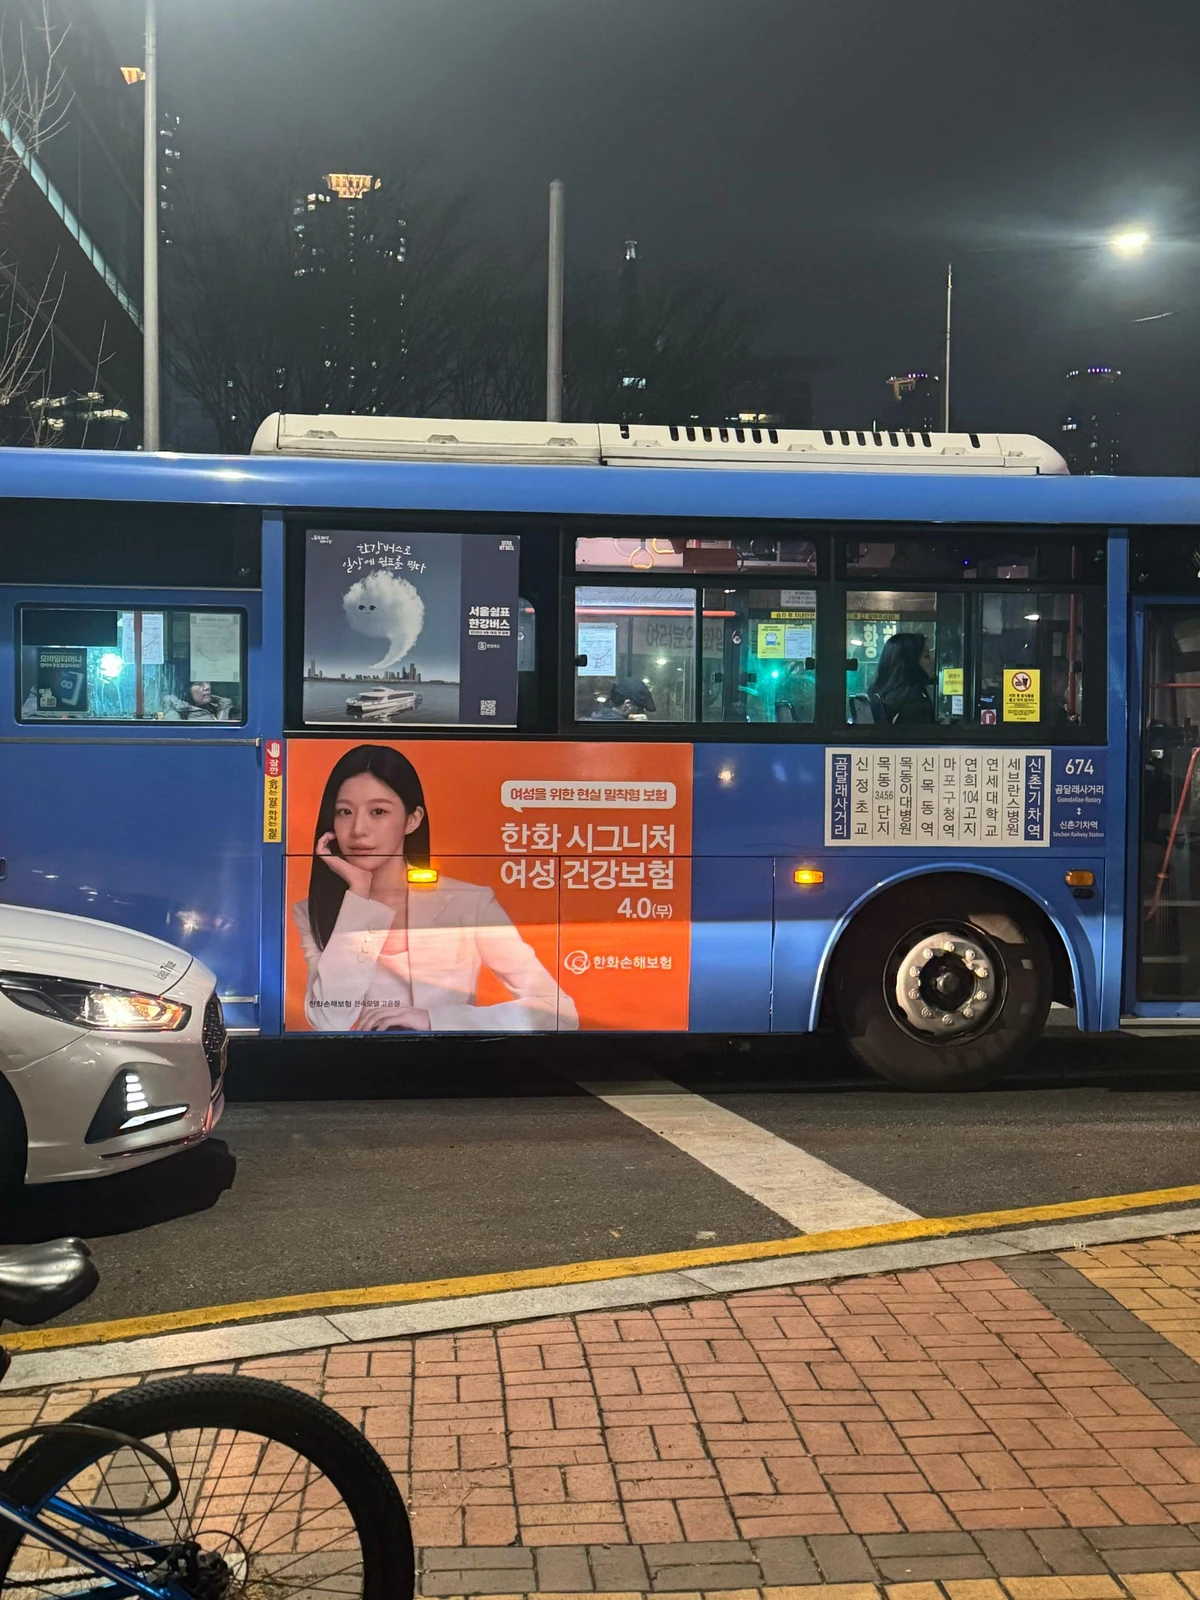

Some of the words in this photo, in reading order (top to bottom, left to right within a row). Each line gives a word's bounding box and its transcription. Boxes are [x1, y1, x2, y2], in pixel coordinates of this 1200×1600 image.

[356, 541, 412, 555] 한강버스로
[342, 557, 375, 574] 일상에
[378, 555, 404, 570] 쉼표를
[468, 606, 510, 617] 서울쉼표
[468, 618, 510, 629] 한강버스
[40, 654, 82, 663] 모바일티머니
[1065, 759, 1094, 775] 674
[510, 788, 547, 801] 여성을
[549, 788, 575, 801] 위한
[577, 788, 601, 801] 현실
[604, 789, 640, 802] 밀착형
[643, 789, 667, 802] 보험
[834, 757, 848, 838] 곰달래사거리
[855, 757, 868, 835] 신정초교
[899, 756, 913, 836] 목동이대병원
[921, 757, 935, 837] 신목동역
[943, 757, 956, 838] 마포구청역
[985, 757, 998, 837] 연세대학교
[1006, 757, 1020, 837] 세브란스병원
[1027, 758, 1042, 839] 신촌기차역
[1055, 784, 1104, 795] 곰달래사거리
[1059, 820, 1098, 829] 신촌기차역
[500, 823, 562, 853] 한화
[566, 823, 675, 854] 시그니처
[500, 859, 555, 889] 여성
[563, 859, 674, 890] 건강보험
[593, 956, 672, 970] 한화손해보험
[309, 1000, 351, 1008] 한화손해보험
[354, 1000, 380, 1008] 전속모델
